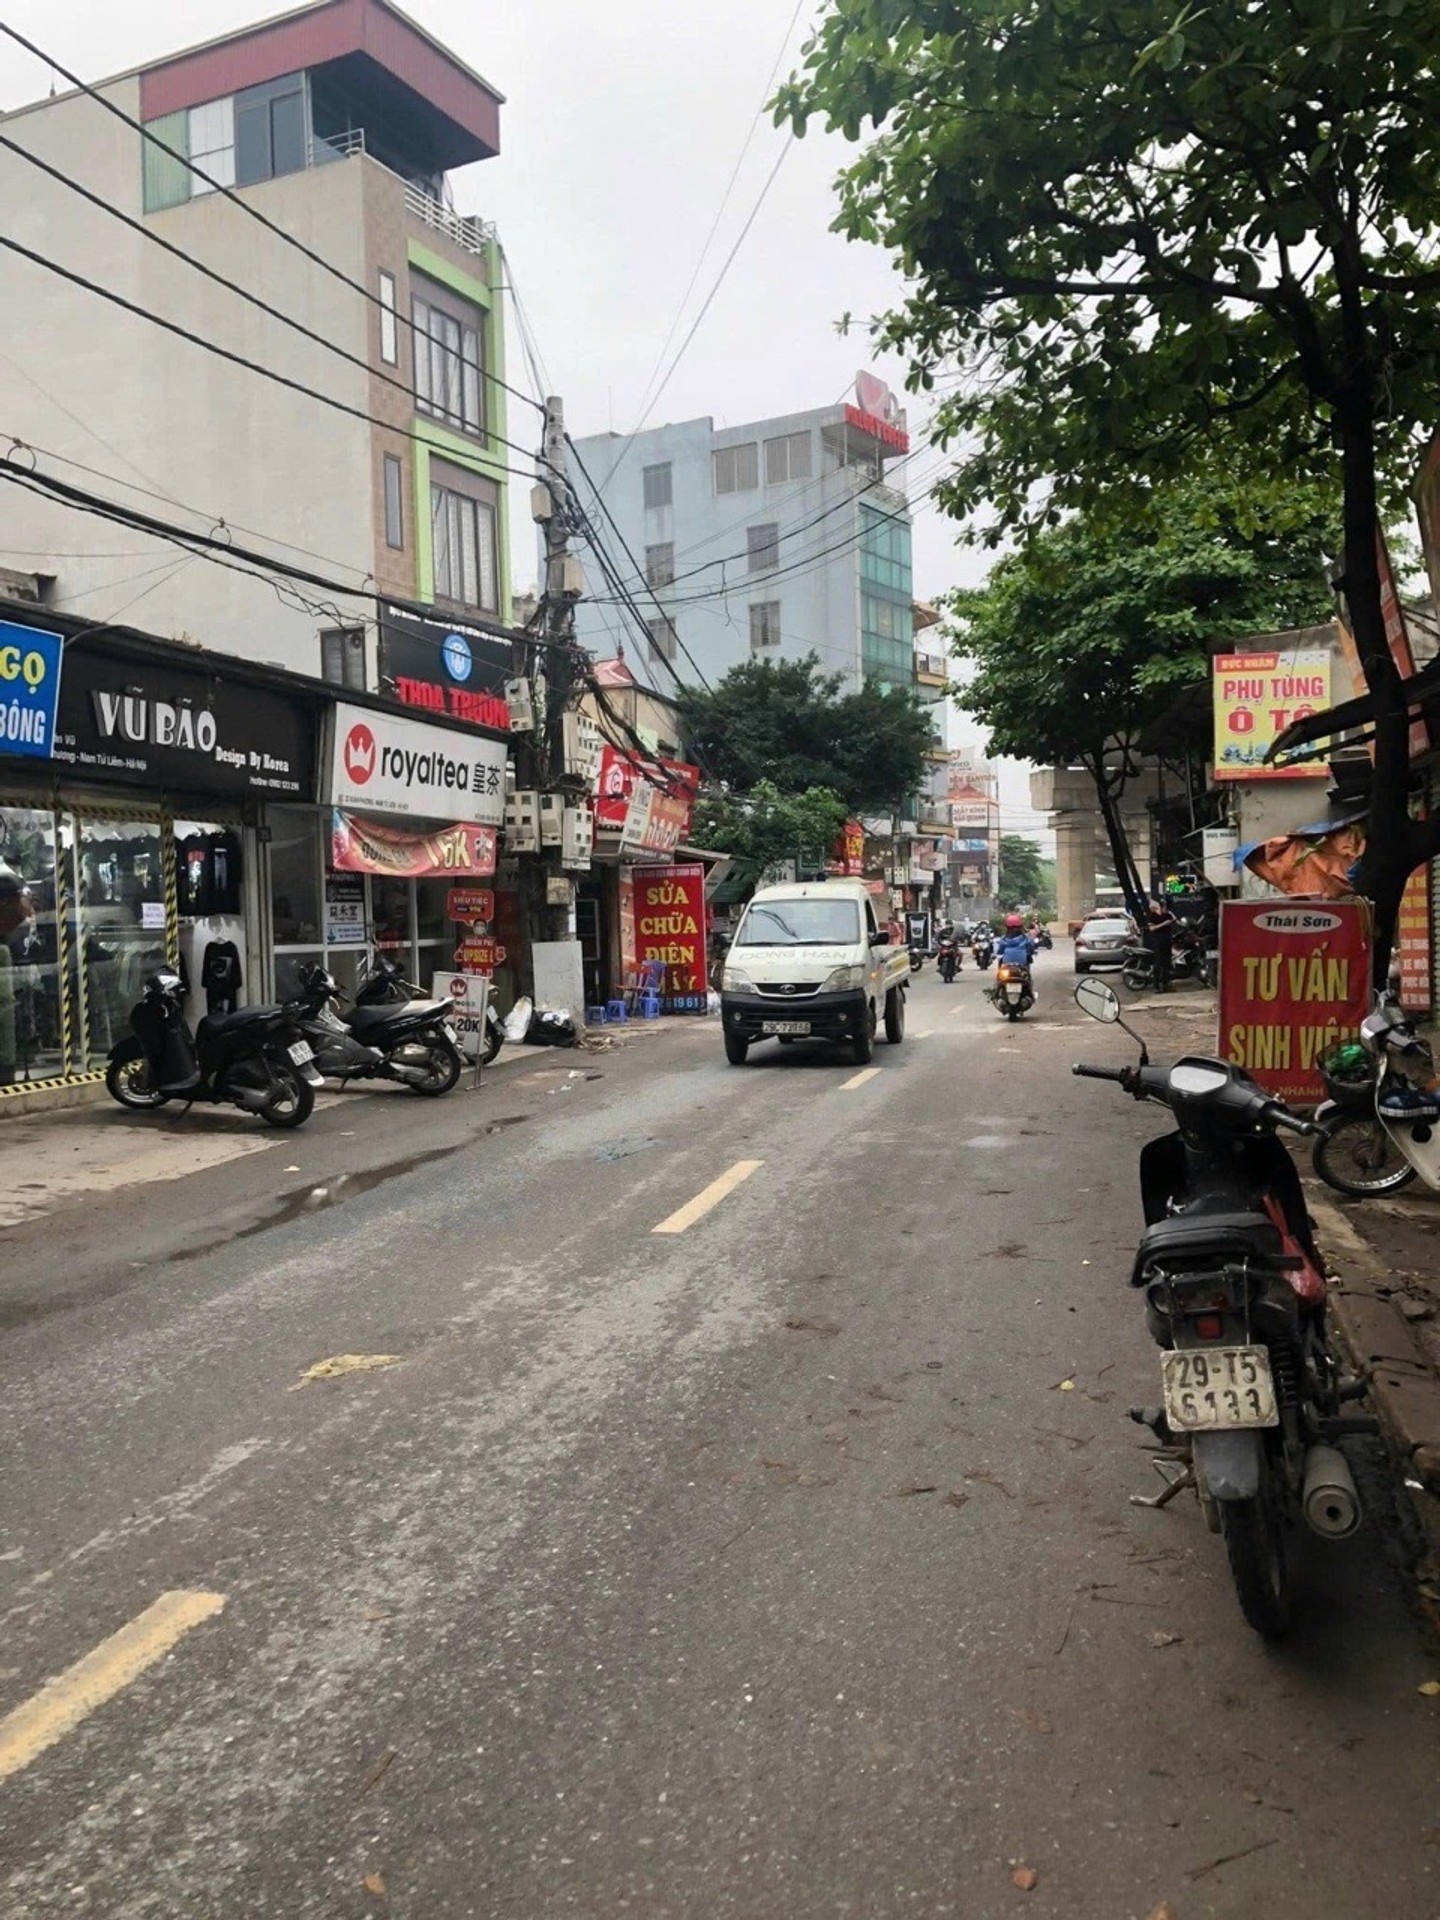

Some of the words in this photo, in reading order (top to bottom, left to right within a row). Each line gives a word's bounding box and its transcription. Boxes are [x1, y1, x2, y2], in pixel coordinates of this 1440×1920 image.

[1223, 680, 1264, 703] PHỤ
[1270, 673, 1325, 698] TÙNG
[96, 685, 147, 742] VŨ
[154, 697, 218, 753] BÃO
[449, 687, 511, 731] TRƯỜN
[1228, 706, 1255, 734] Ô
[381, 746, 469, 791] royaltea
[646, 879, 690, 906] SỬA
[640, 910, 698, 936] CHỮA
[1265, 914, 1299, 928] Thái
[1301, 914, 1334, 928] Sơn
[1242, 952, 1282, 1002] TƯ
[1288, 940, 1348, 1003] VẤN
[1229, 1024, 1291, 1070] SINH
